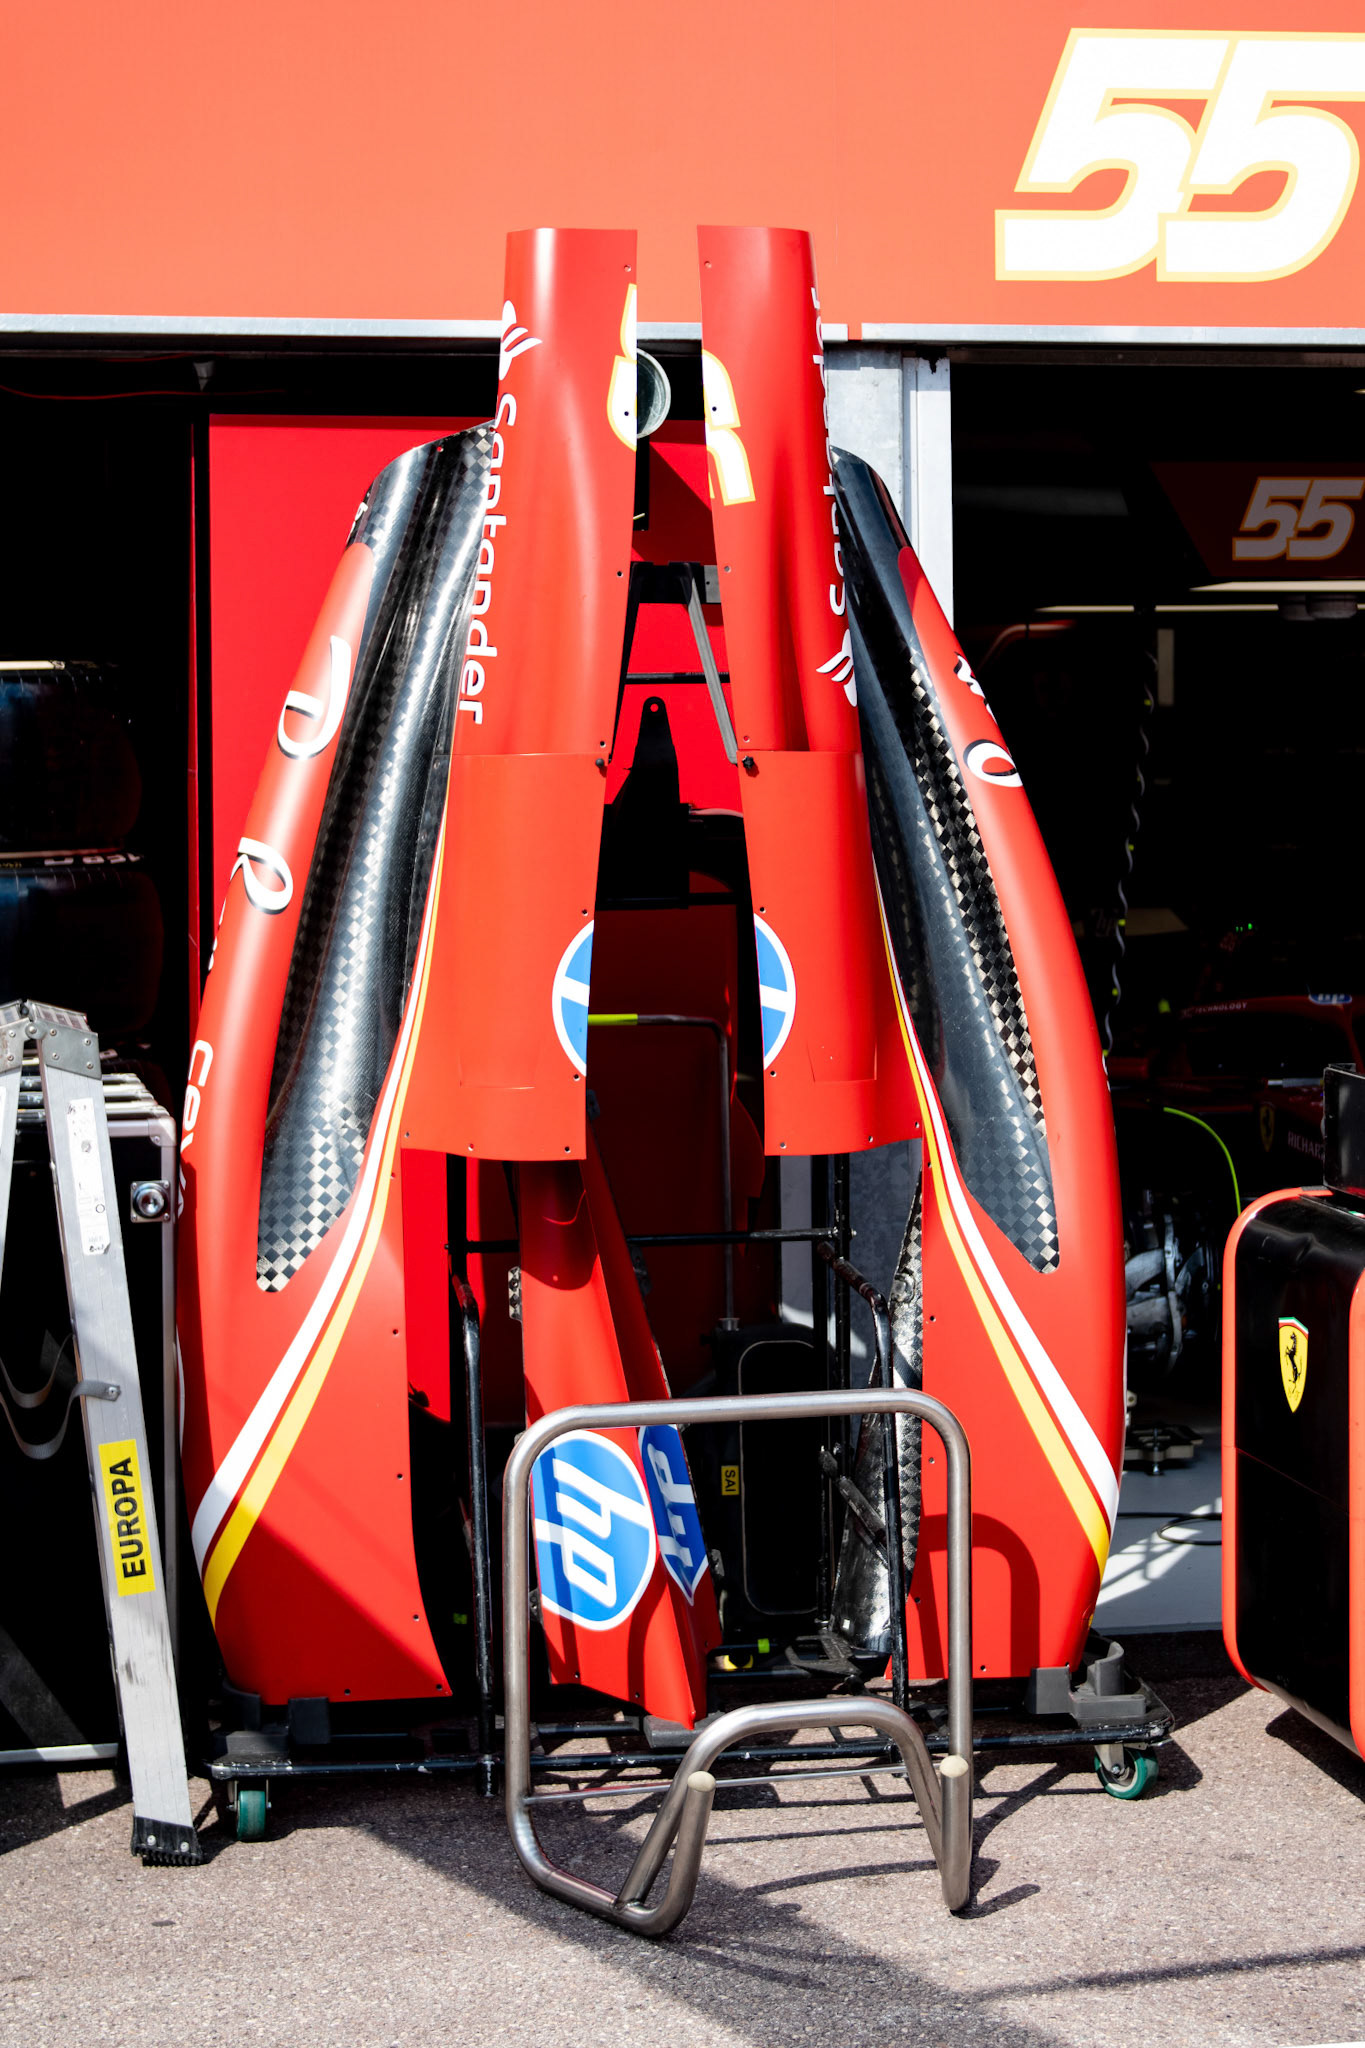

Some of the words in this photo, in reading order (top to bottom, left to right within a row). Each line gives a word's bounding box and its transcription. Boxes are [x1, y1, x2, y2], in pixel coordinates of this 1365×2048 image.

[995, 27, 1365, 283] 55
[1232, 476, 1365, 561] 55
[1287, 1130, 1324, 1160] RICHAR
[109, 1456, 147, 1580] EUROPA
[724, 1469, 737, 1492] SAI
[535, 1457, 652, 1609] hp
